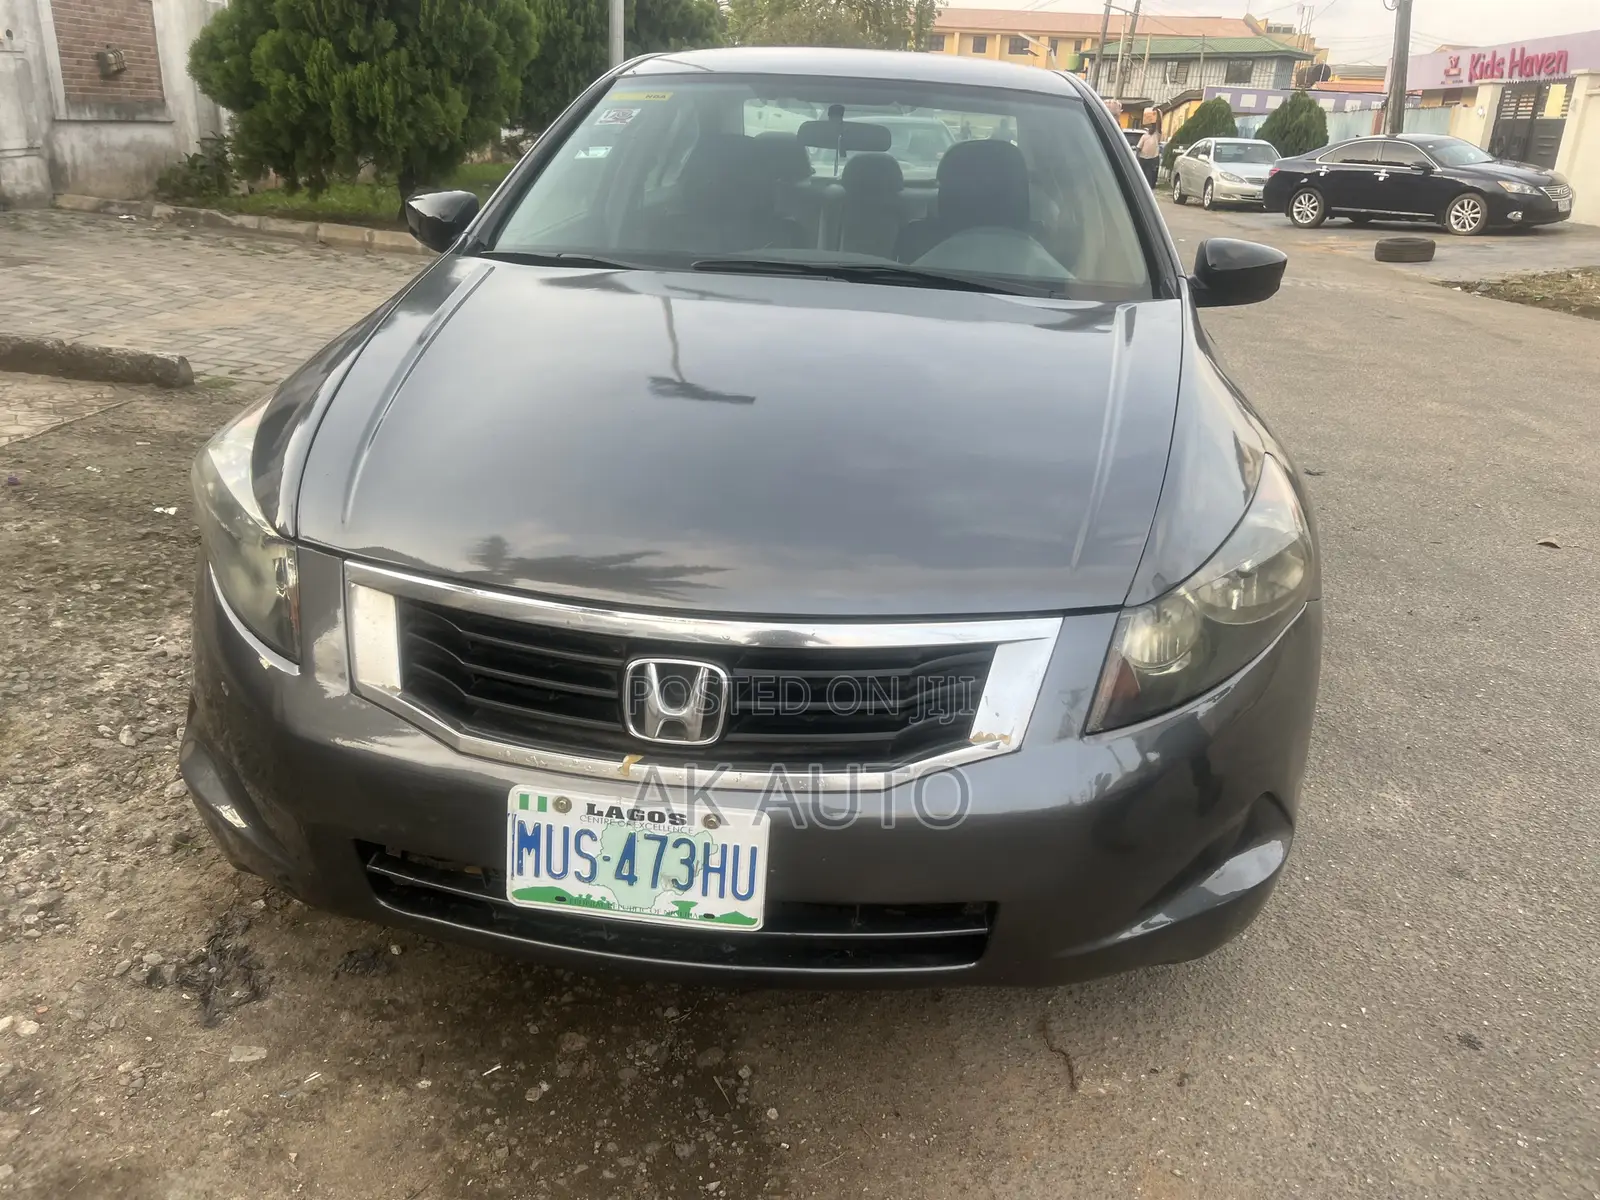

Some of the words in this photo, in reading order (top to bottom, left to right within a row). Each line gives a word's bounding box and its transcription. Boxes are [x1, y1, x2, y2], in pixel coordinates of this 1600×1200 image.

[1468, 50, 1505, 83] Kids
[1508, 47, 1569, 78] Haven
[579, 814, 616, 826] CENTRE
[634, 822, 694, 835] EXCELLENCE
[586, 802, 688, 826] LAGOS
